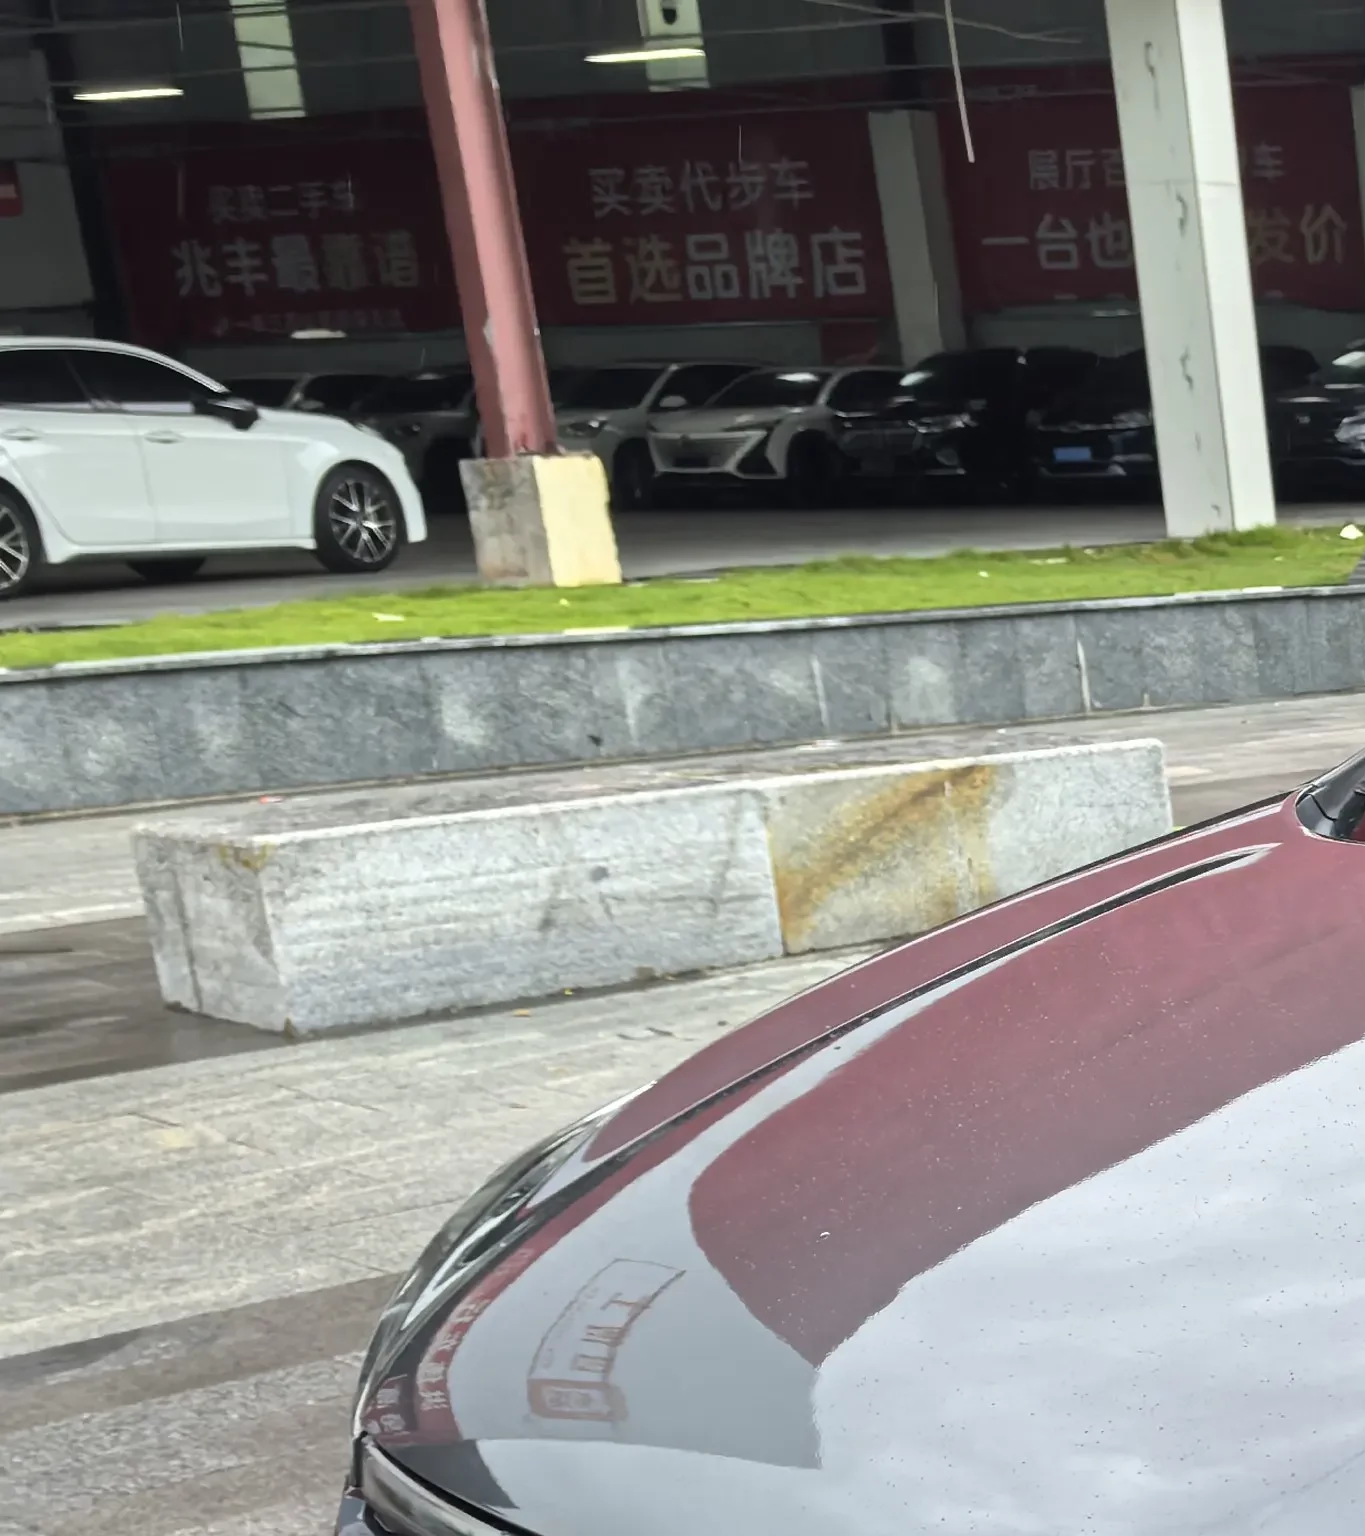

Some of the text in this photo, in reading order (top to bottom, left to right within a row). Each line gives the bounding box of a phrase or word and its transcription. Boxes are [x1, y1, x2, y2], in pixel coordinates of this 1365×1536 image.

[587, 157, 815, 219] 买卖代步车
[561, 226, 867, 305] 首选品牌店
